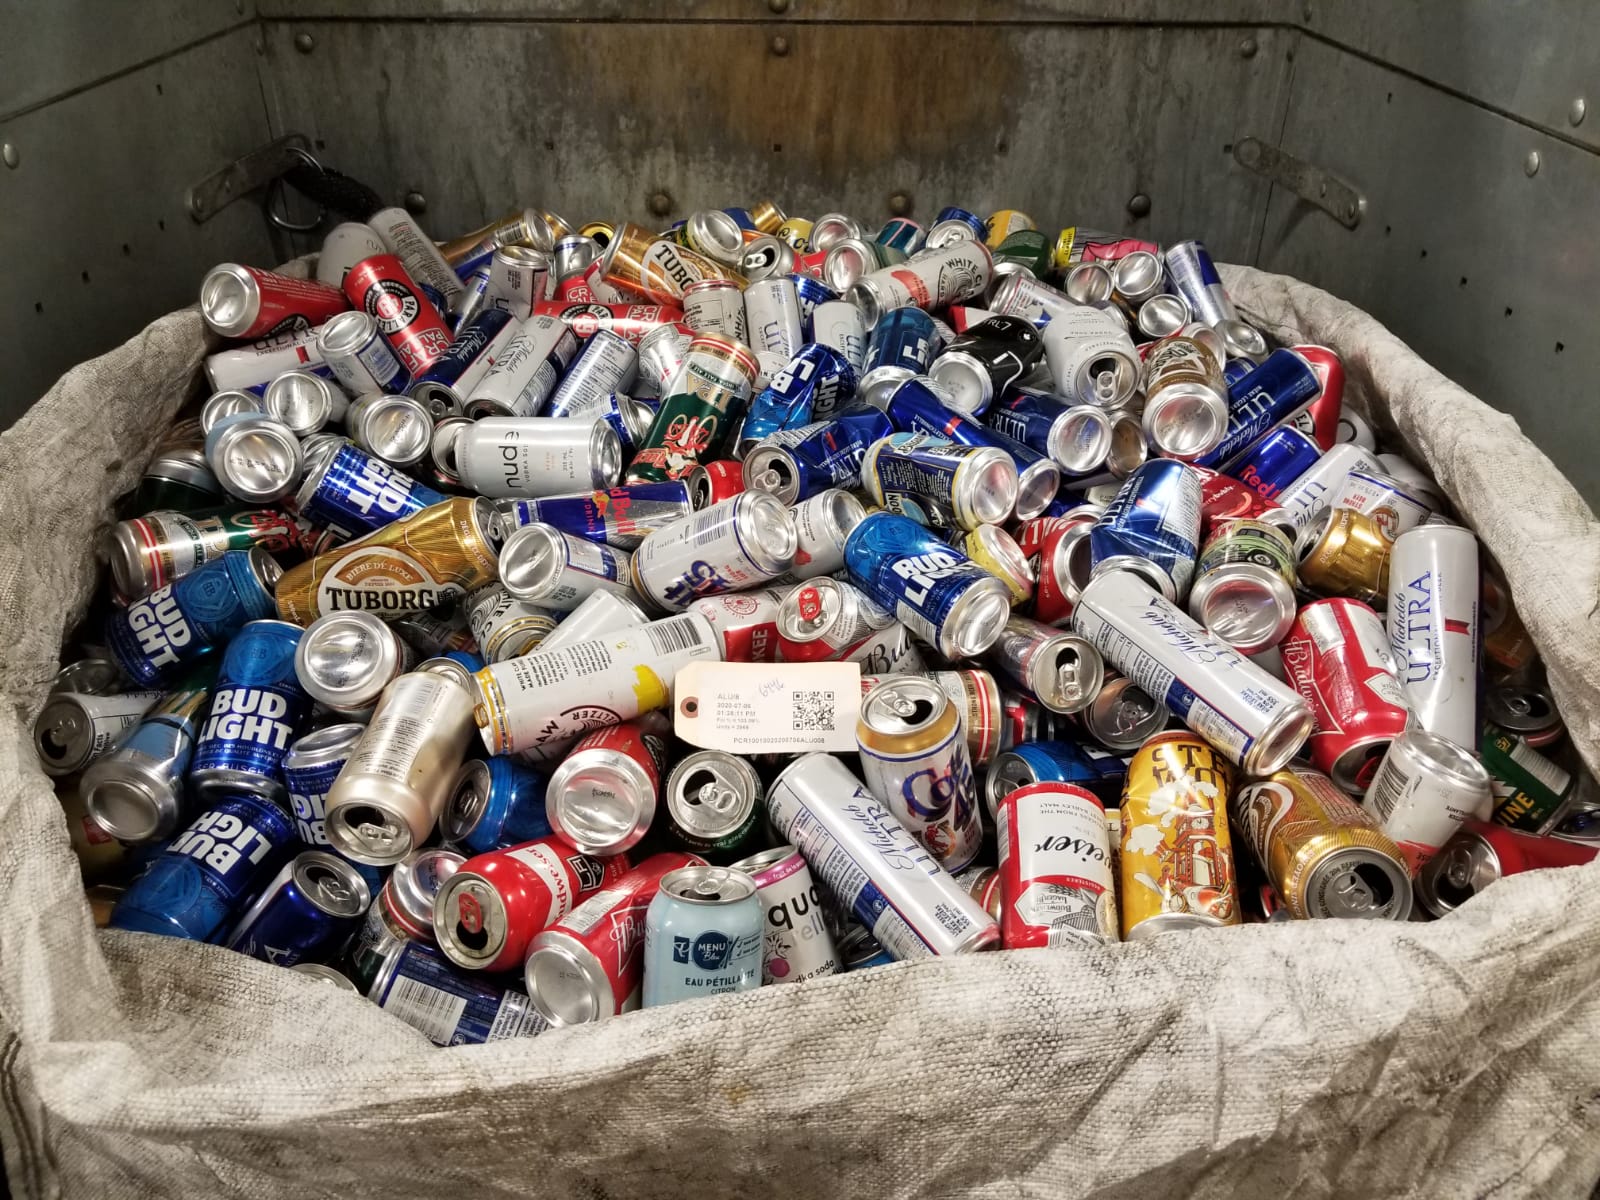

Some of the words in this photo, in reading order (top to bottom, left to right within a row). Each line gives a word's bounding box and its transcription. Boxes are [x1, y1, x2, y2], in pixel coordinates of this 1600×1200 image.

[655, 244, 688, 292] TUBO
[252, 327, 320, 350] ULTR
[498, 431, 522, 489] nude
[149, 583, 191, 647] BUD
[326, 587, 434, 612] TUBORG
[128, 598, 180, 669] IGHT
[1139, 611, 1217, 665] Michelob
[1391, 592, 1406, 672] Michelob
[1407, 570, 1431, 684] ULTRA
[211, 689, 287, 719] BUD
[198, 713, 294, 750] LIGHT
[193, 811, 272, 865] LIGH
[841, 803, 915, 871] Michelob
[527, 848, 566, 920] udweiser
[698, 942, 727, 951] MENU
[815, 959, 835, 979] soda
[685, 976, 704, 987] EAU
[711, 985, 737, 995] CITRON
